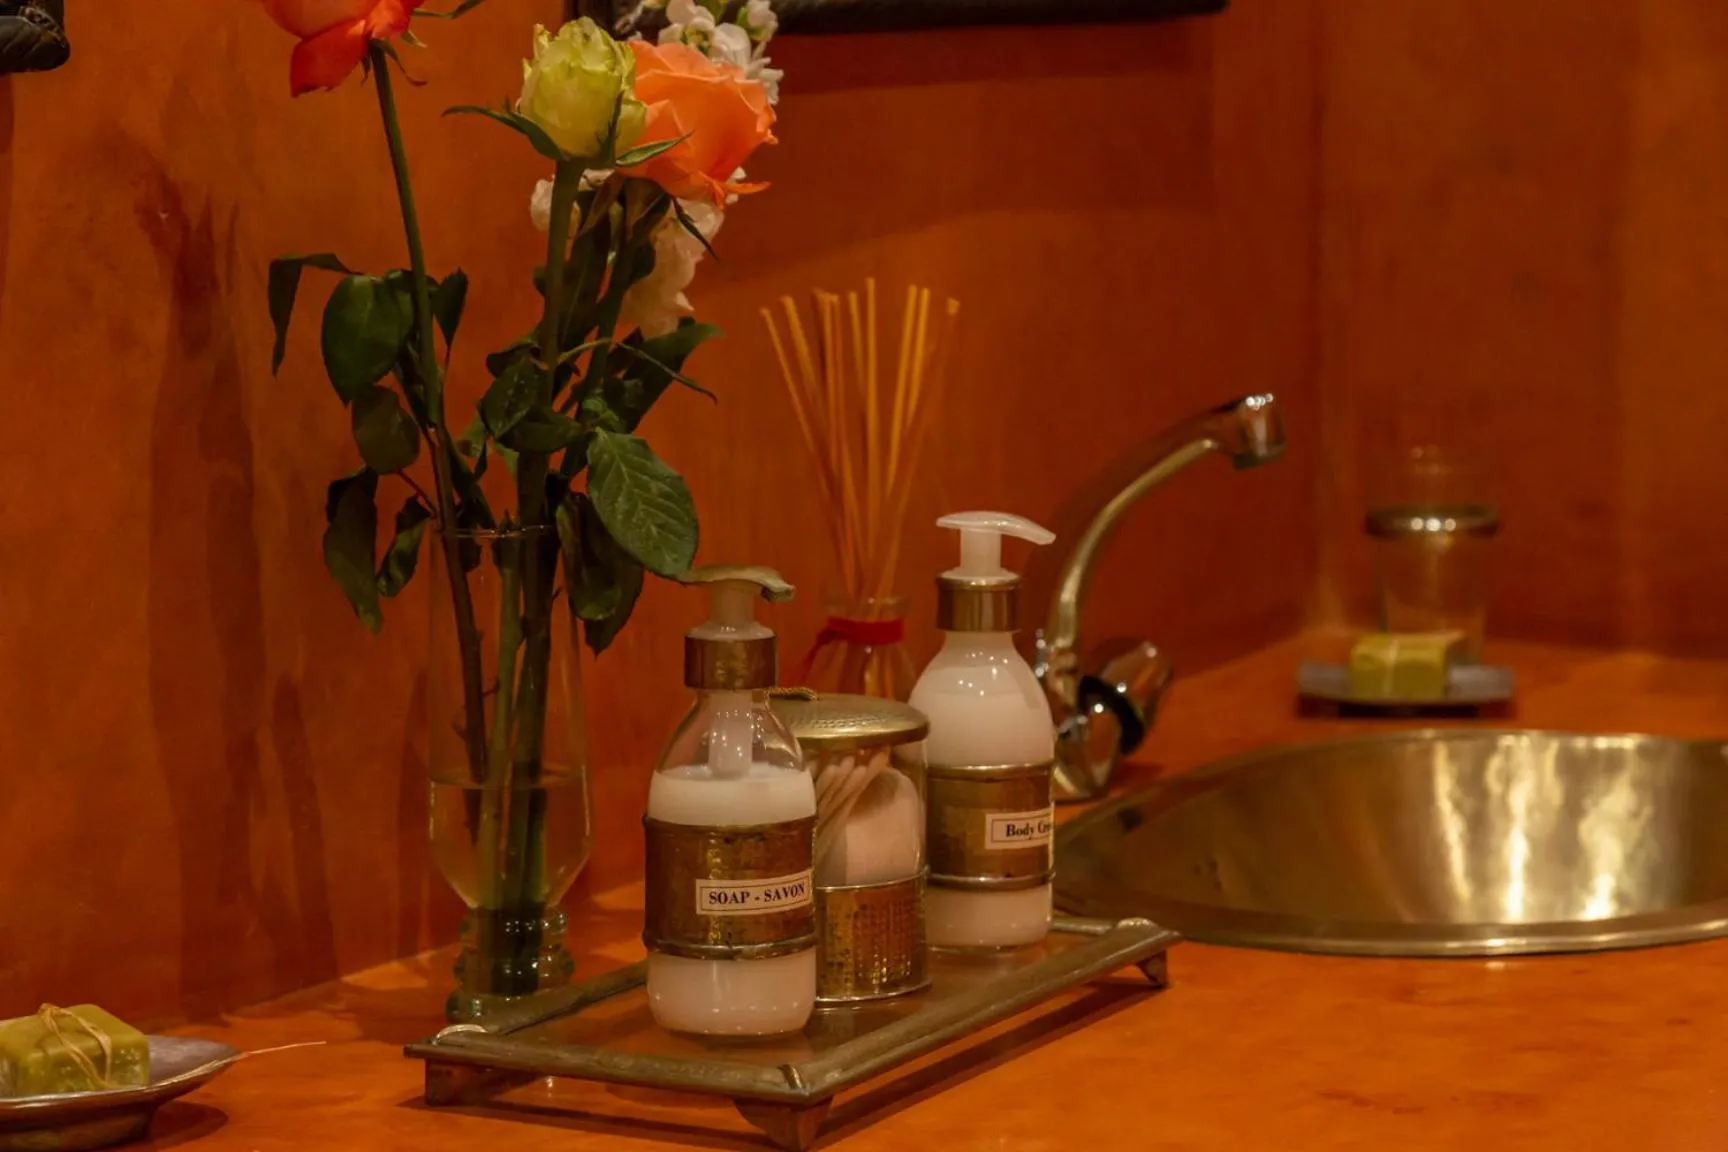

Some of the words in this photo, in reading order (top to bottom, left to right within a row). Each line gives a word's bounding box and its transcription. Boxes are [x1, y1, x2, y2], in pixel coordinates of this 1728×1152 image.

[1006, 822, 1034, 840] Body
[708, 890, 750, 905] SOAP
[764, 881, 806, 902] SAVON
